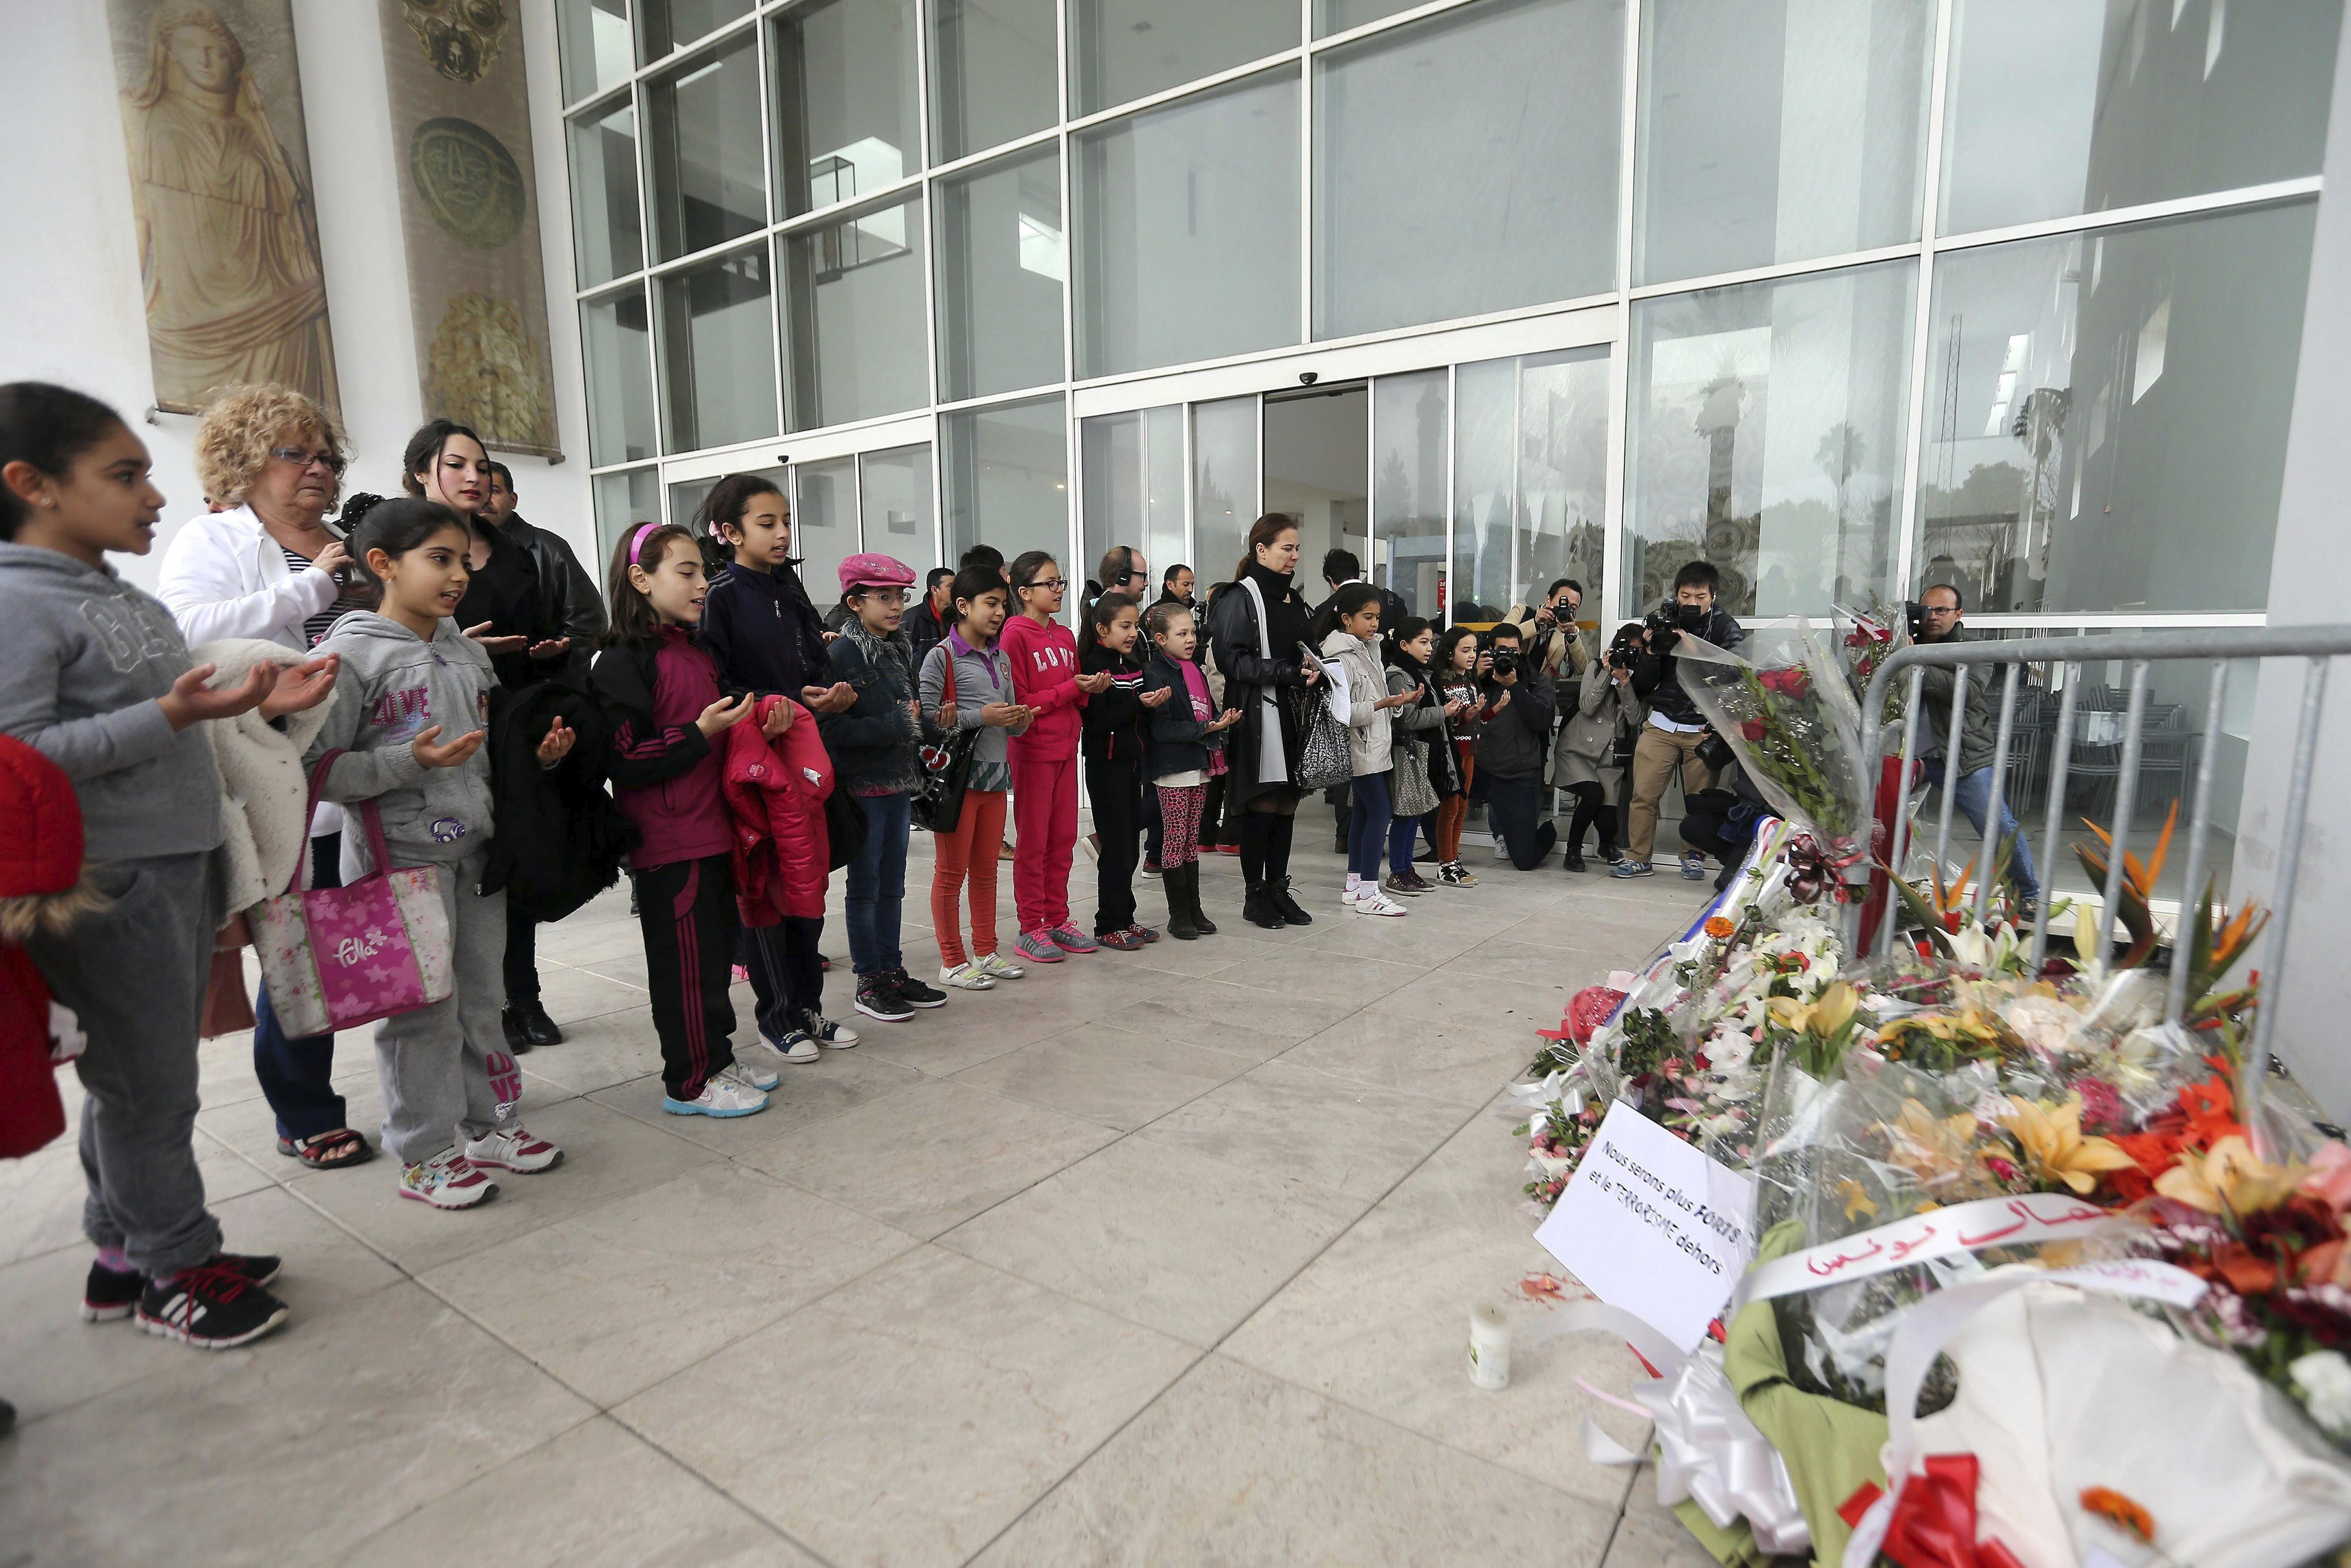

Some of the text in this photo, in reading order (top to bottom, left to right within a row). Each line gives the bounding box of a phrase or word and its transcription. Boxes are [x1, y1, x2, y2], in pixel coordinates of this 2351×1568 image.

[1033, 647, 1075, 672] LOVE
[371, 686, 432, 725] LOVE
[1601, 1140, 1629, 1167] Nous
[1628, 1162, 1665, 1192] serons
[1663, 1187, 1694, 1212] plus
[1589, 1170, 1601, 1185] et
[1600, 1175, 1612, 1192] le
[1676, 1233, 1722, 1275] dehors
